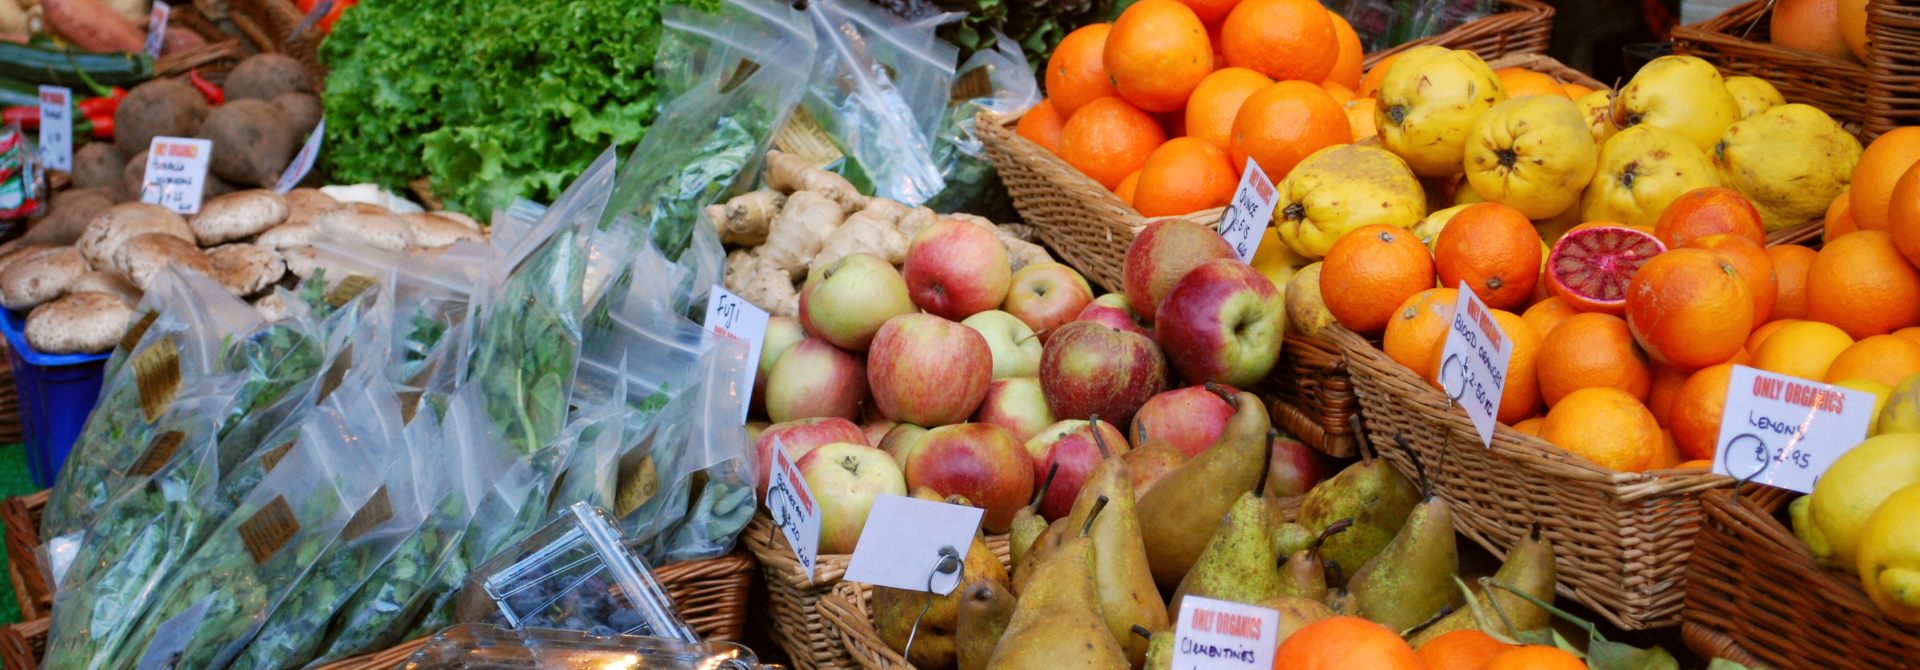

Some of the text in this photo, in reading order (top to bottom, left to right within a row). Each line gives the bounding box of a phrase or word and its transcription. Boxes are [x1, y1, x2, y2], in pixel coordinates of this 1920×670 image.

[1753, 375, 1845, 415] ONLY ORGANICS
[1749, 410, 1806, 441] LEMONS
[1192, 608, 1263, 641] ONLY ORGANICS
